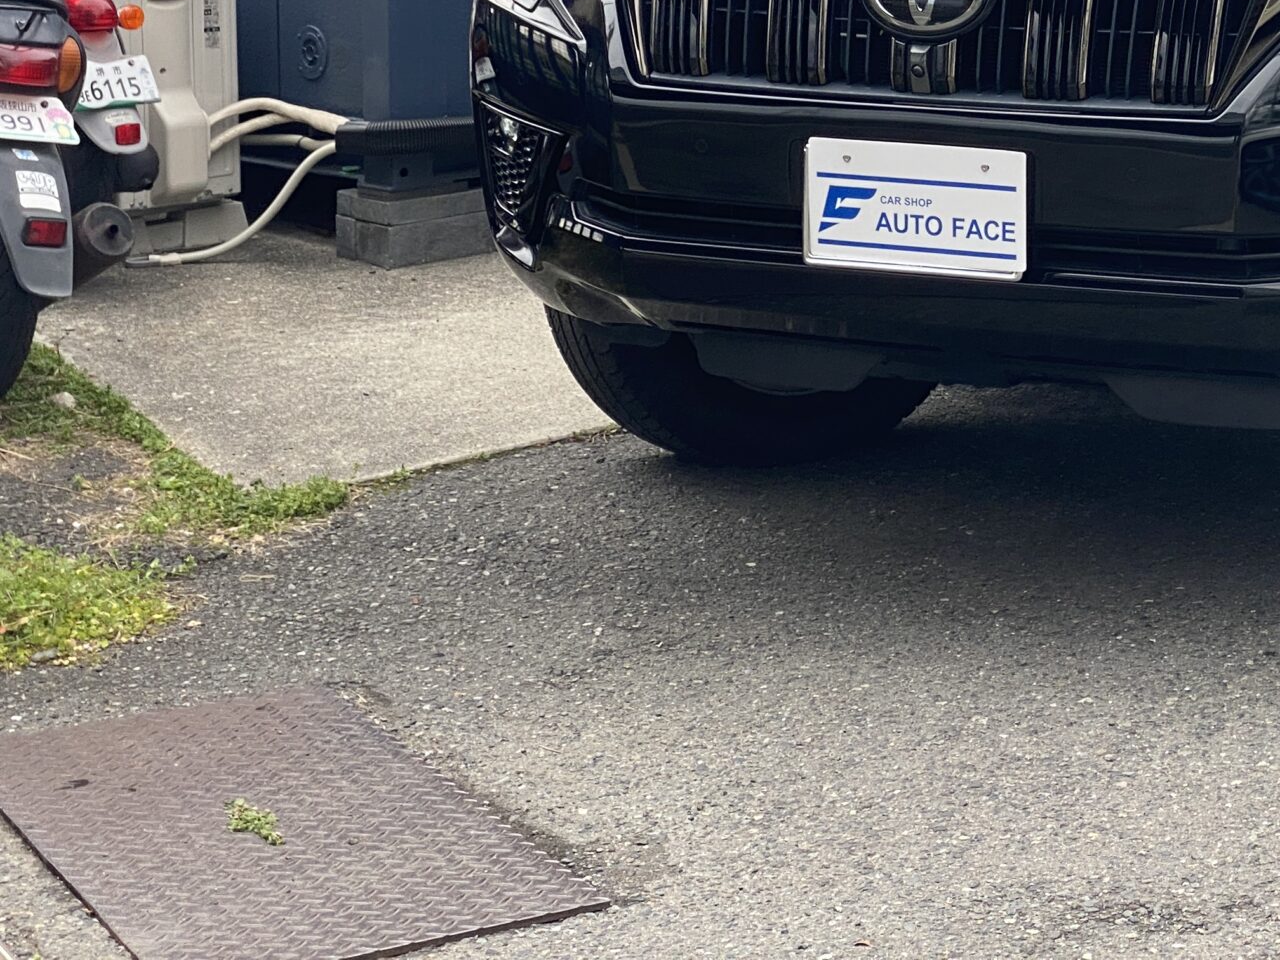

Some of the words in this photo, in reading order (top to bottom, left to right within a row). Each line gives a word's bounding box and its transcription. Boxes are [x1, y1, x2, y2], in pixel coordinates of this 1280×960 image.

[90, 76, 142, 101] 6115
[880, 195, 902, 206] CAR
[904, 197, 933, 208] SHOP
[875, 212, 943, 236] AUTO
[952, 218, 1016, 243] FACE
